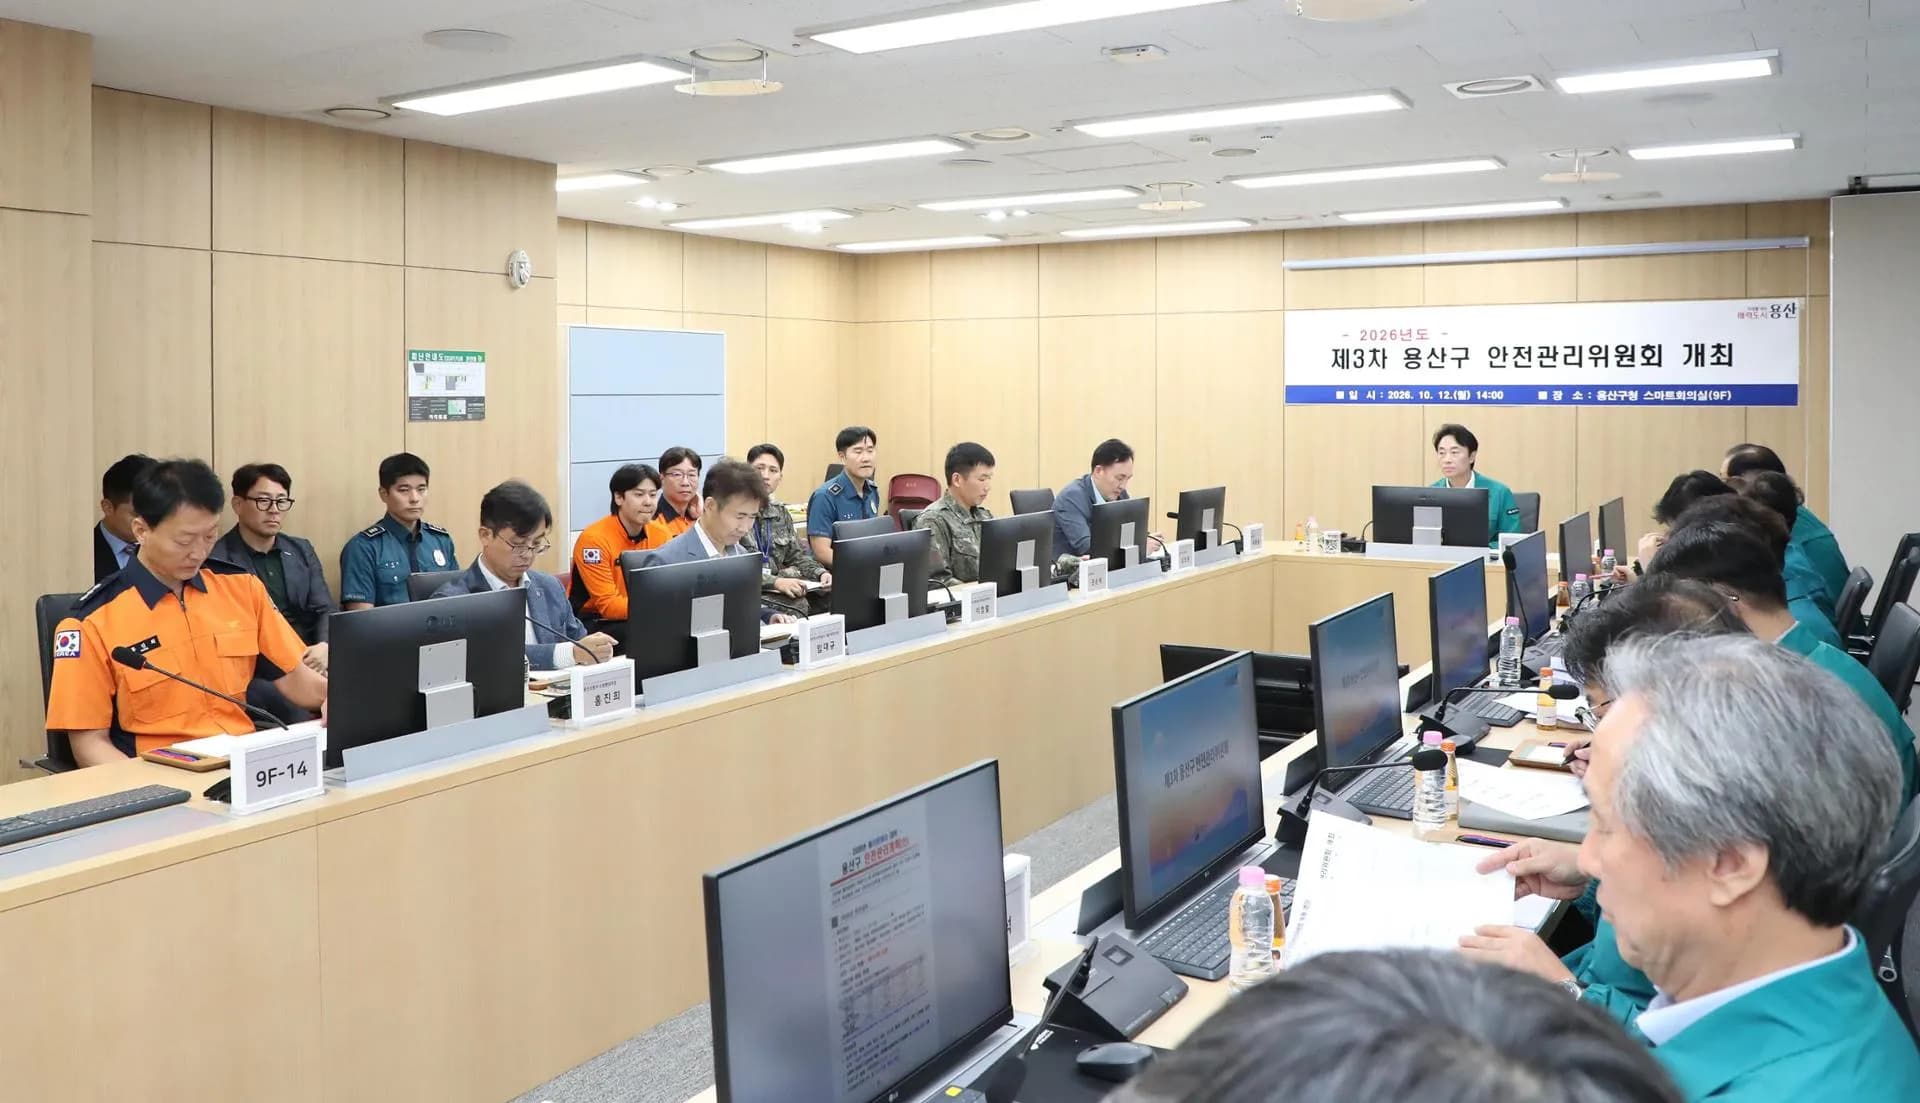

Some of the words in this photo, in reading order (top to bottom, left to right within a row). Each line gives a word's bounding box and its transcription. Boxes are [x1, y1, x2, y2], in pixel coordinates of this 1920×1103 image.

[1769, 302, 1797, 319] 용산
[1359, 328, 1430, 342] 2026년도
[1331, 347, 1388, 370] 제3차
[1403, 347, 1470, 370] 용산구
[1488, 343, 1663, 369] 안전관리위원회
[1682, 342, 1733, 368] 개최
[1388, 390, 1414, 400] 2026.
[1419, 390, 1434, 400] 10.
[1477, 390, 1504, 400] 14:00
[1597, 390, 1638, 401] 용산구청
[1643, 390, 1732, 401] 스마트회의실(9F)
[256, 760, 308, 788] 9F-14
